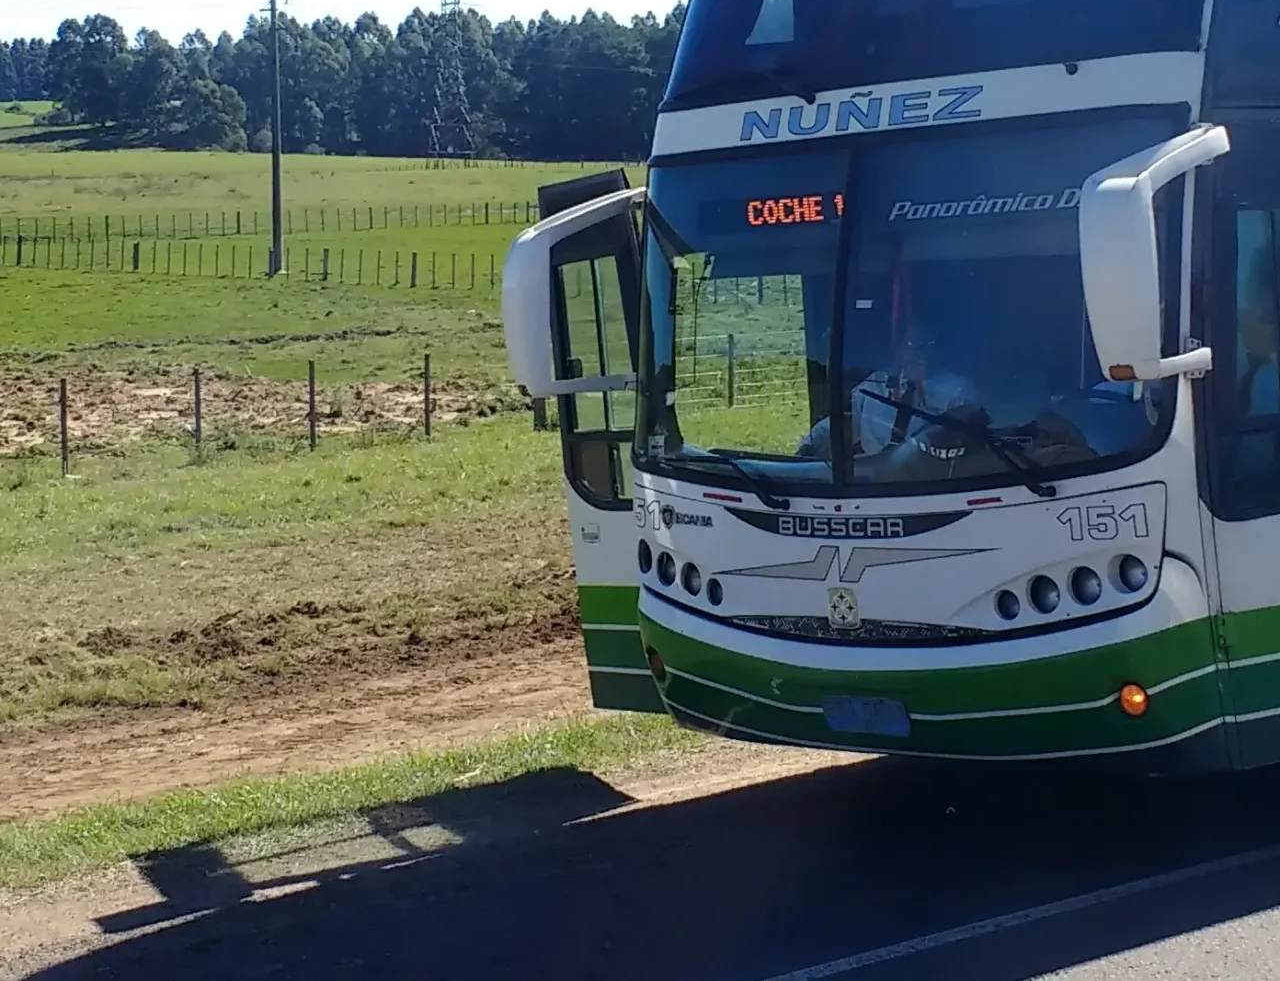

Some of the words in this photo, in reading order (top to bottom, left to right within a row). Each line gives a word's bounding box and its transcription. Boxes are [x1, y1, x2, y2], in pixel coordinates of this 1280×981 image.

[740, 85, 984, 142] NUÑEZ
[747, 196, 824, 225] COCHE
[888, 192, 1054, 221] Panorâmico
[1056, 188, 1083, 208] D
[675, 511, 714, 527] SCANIA
[778, 516, 904, 537] BUSSCAR
[1056, 502, 1149, 541] 151
